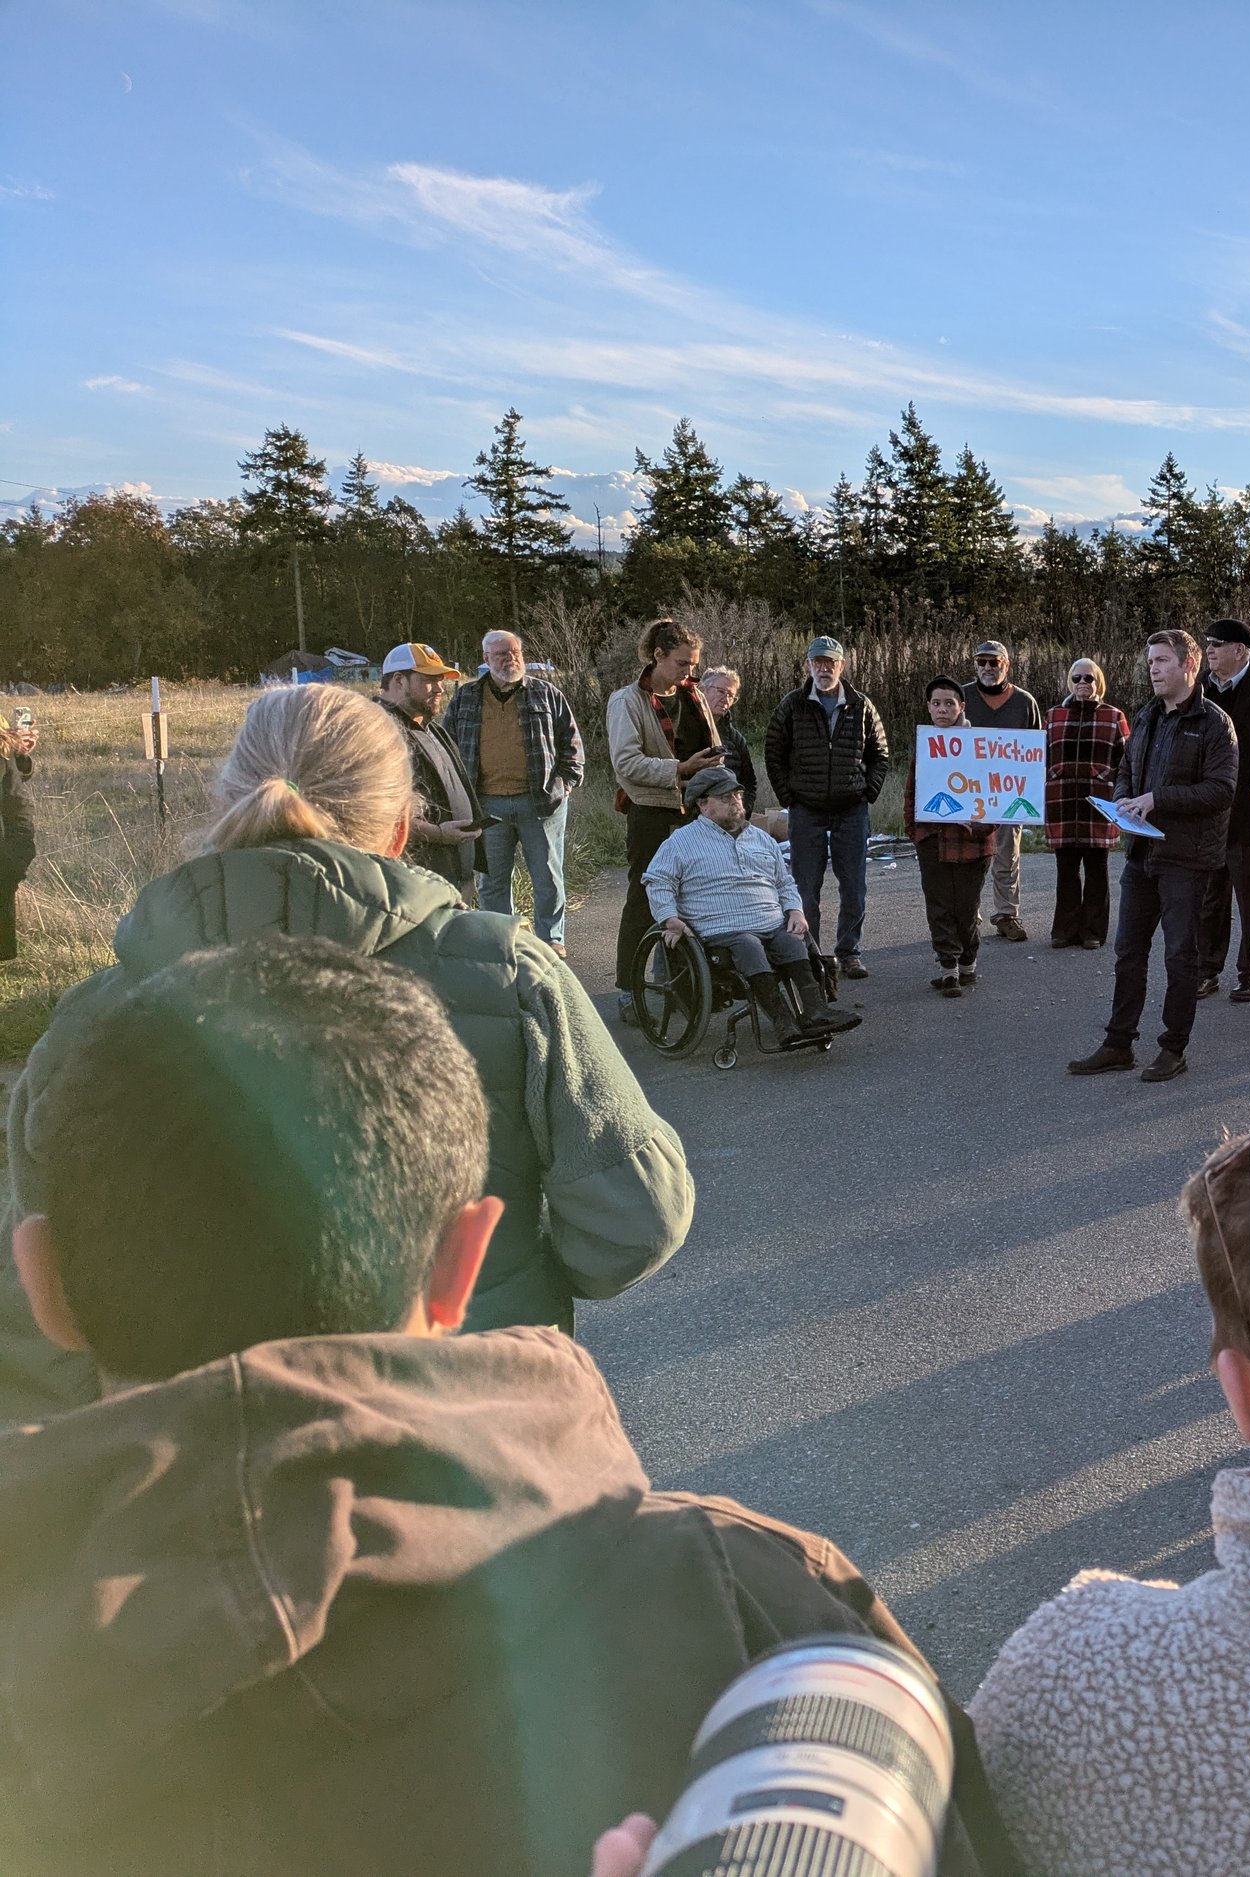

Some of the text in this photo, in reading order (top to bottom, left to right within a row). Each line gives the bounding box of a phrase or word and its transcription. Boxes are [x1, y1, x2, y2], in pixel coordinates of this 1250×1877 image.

[928, 735, 1043, 762] NO Eviction
[948, 771, 981, 794] On
[971, 796, 998, 820] 3rd
